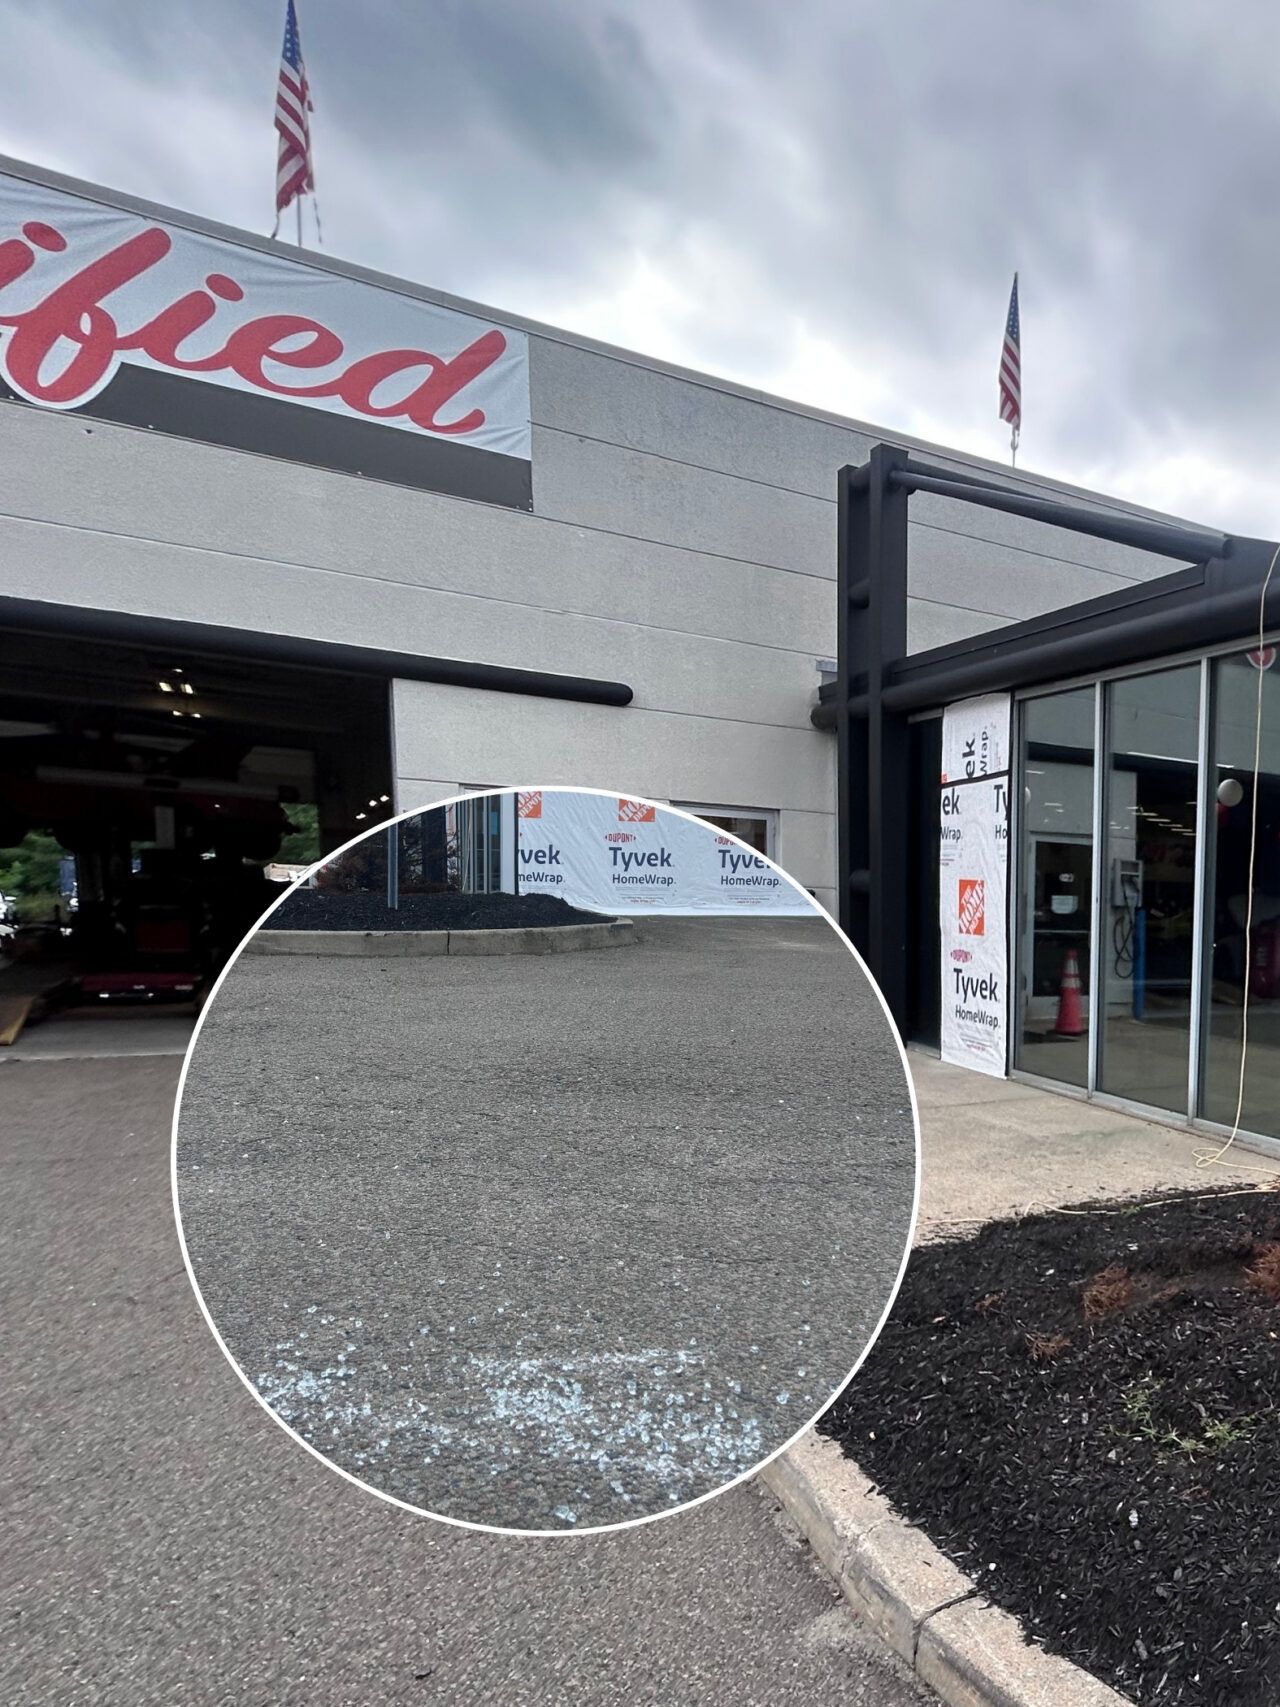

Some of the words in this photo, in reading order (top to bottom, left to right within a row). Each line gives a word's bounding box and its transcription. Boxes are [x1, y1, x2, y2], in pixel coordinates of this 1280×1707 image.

[608, 833, 634, 842] DUPONT
[518, 844, 560, 865] vek
[609, 847, 672, 872] Tyvek
[718, 850, 771, 874] Tyve
[612, 873, 674, 886] HomeWrap
[721, 875, 779, 888] HomeWrap
[953, 968, 998, 1003] Tyvek
[955, 1004, 999, 1031] HomeWrap
